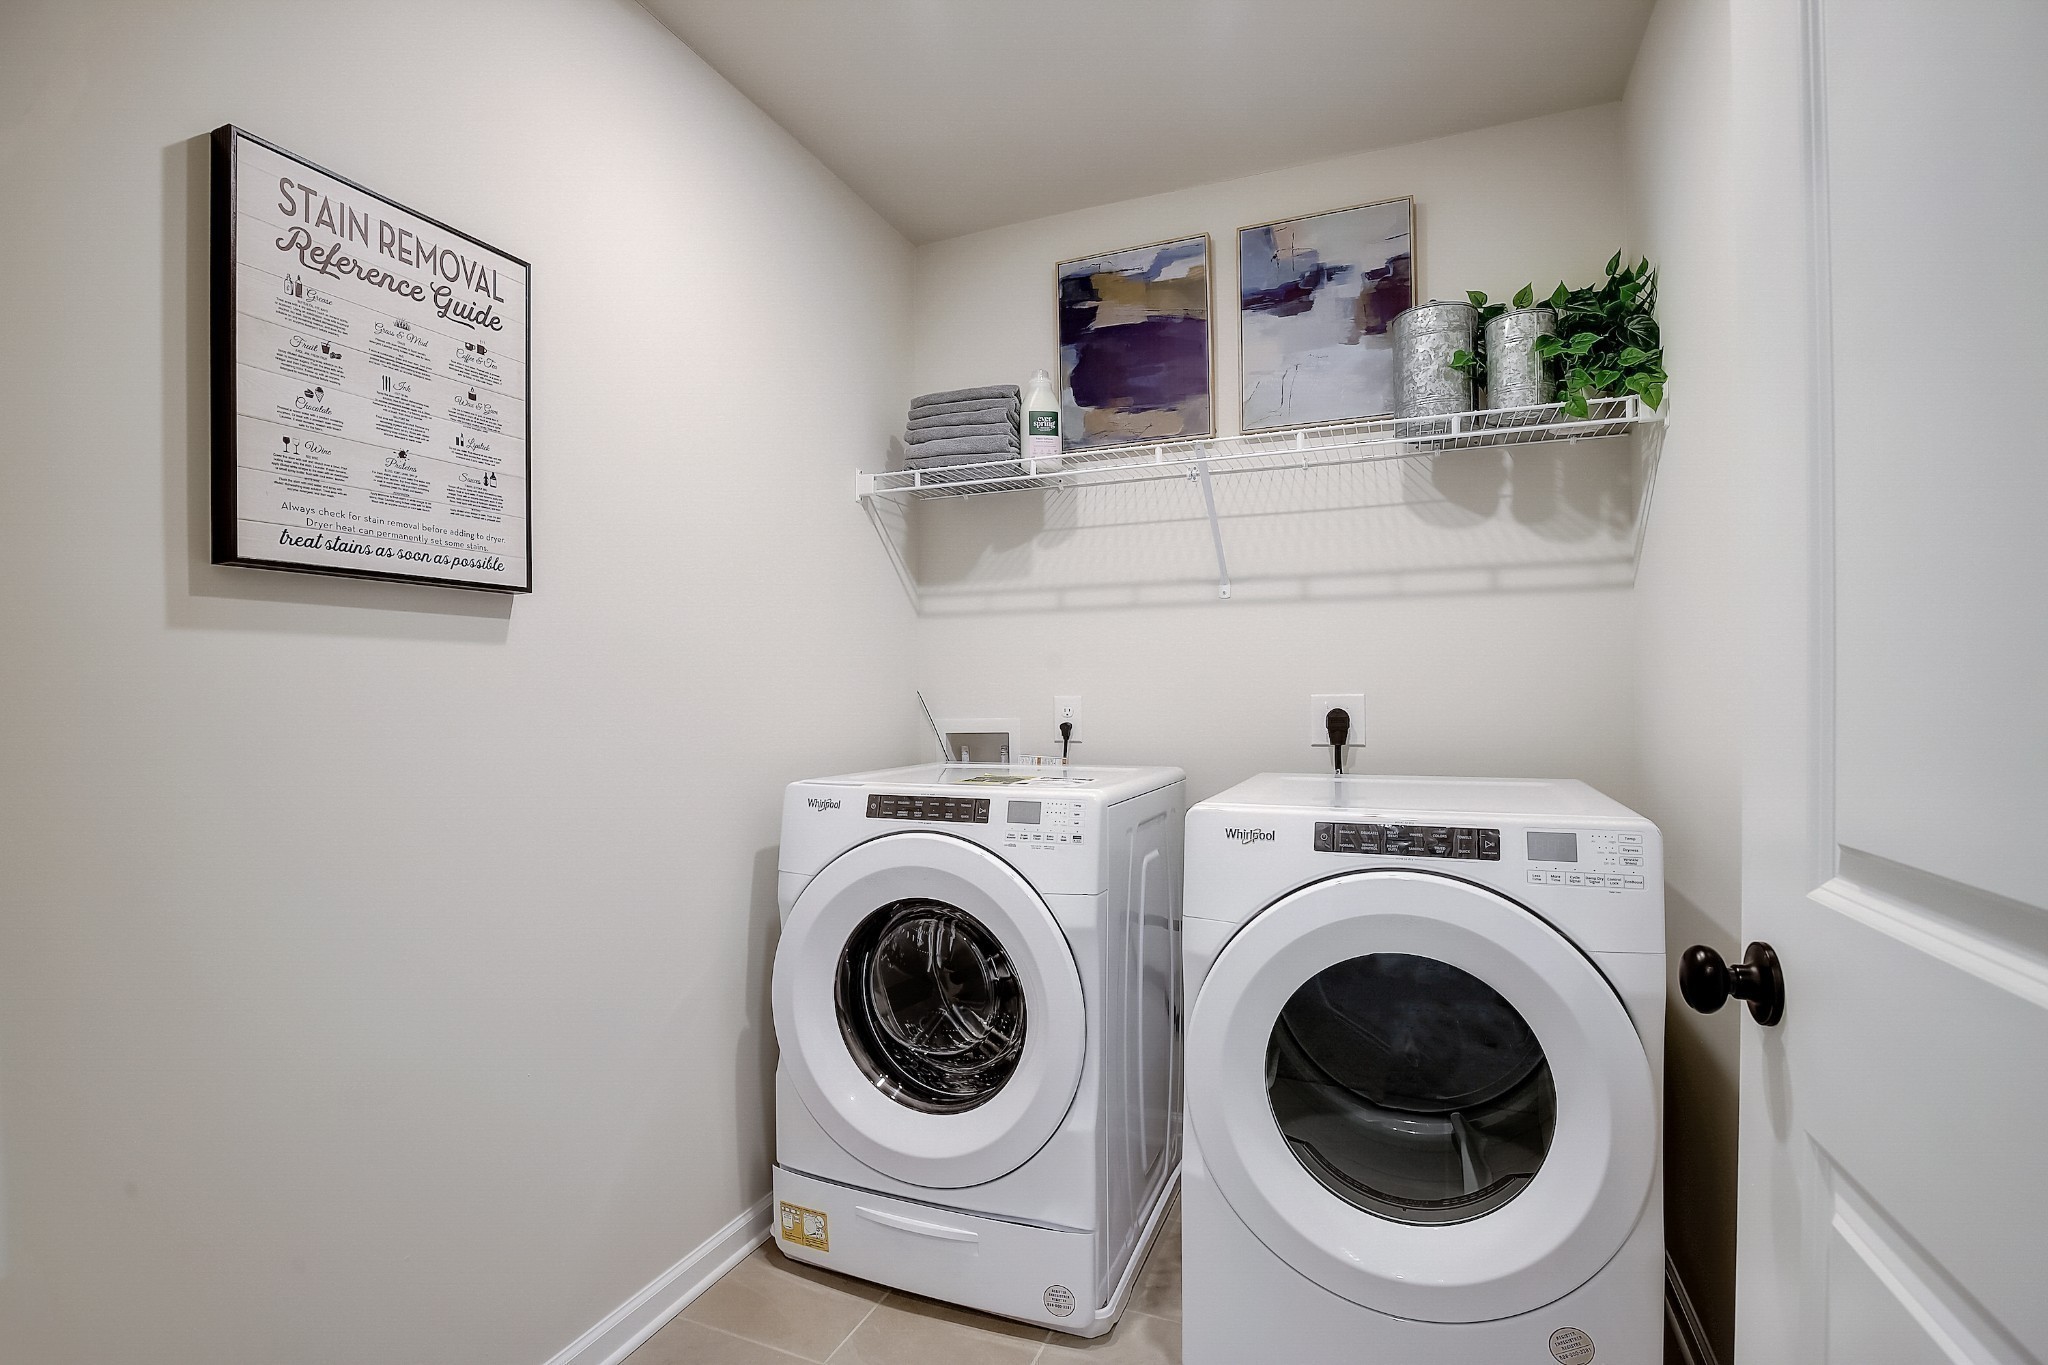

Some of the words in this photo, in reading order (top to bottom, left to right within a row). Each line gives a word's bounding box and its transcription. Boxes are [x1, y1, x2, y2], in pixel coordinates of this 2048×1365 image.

[278, 177, 369, 248] STAIN
[379, 219, 504, 303] REMOVAL
[275, 226, 426, 302] Reference
[430, 282, 503, 332] Guide
[306, 287, 333, 305] Grease
[289, 335, 319, 352] Fruit
[406, 333, 429, 347] Mud
[456, 347, 475, 363] Coffee
[484, 357, 498, 369] Tea
[392, 381, 411, 392] Ink
[295, 395, 332, 415] Chocolate
[1033, 420, 1056, 429] spring
[304, 440, 332, 455] Wine
[466, 437, 490, 452] Lipstick
[384, 457, 417, 473] Proteins
[281, 501, 316, 515] Always
[318, 507, 346, 519] check
[348, 512, 361, 521] for
[364, 515, 385, 525] stain
[387, 520, 420, 530] removal
[422, 523, 448, 535] before
[449, 529, 475, 540] adding
[476, 532, 484, 540] to
[486, 533, 506, 544] dryer.
[306, 517, 333, 530] Dryer
[335, 522, 356, 533] heat
[358, 528, 374, 536] can
[376, 530, 428, 545] permanently
[430, 538, 443, 546] set
[444, 539, 465, 548] some
[466, 542, 489, 552] stains.
[280, 528, 323, 549] treat
[324, 535, 374, 556] stains
[375, 546, 395, 558] as
[397, 548, 432, 563] soon
[433, 554, 451, 565] as
[450, 555, 505, 572] possible
[807, 798, 841, 812] Whirlpool
[1225, 828, 1275, 845] Whirlpool
